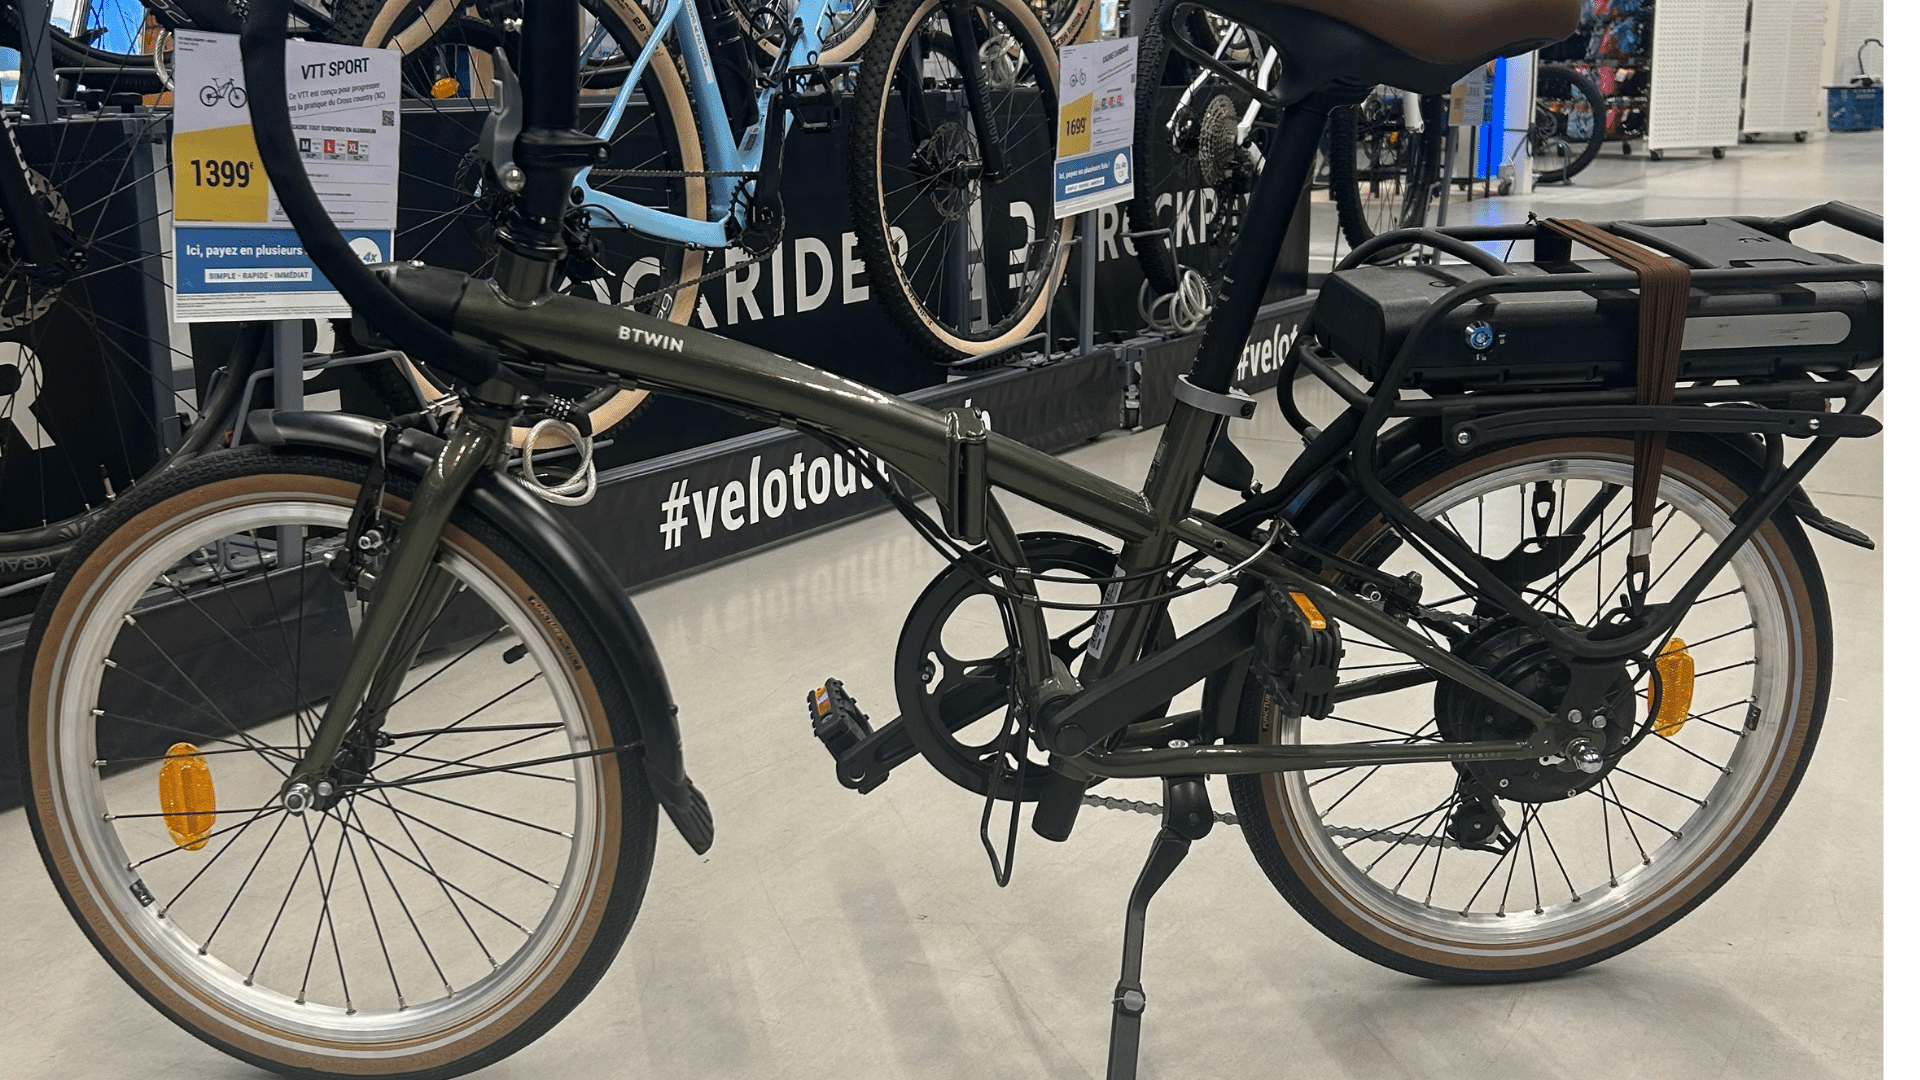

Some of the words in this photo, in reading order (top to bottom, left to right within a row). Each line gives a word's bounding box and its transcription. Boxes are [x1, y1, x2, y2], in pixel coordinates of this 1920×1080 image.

[632, 17, 646, 32] 29
[301, 62, 327, 80] VTT
[328, 57, 370, 78] SPORT
[288, 92, 296, 100] Ce
[298, 90, 310, 100] VTT
[310, 88, 320, 98] est
[320, 87, 337, 98] conçu
[337, 86, 352, 96] pour
[351, 82, 380, 94] progresser
[304, 100, 328, 112] pratique
[328, 97, 336, 107] du
[336, 96, 352, 105] Cross
[352, 93, 374, 104] country
[374, 90, 386, 102] (XC)
[301, 140, 310, 150] M
[348, 142, 358, 152] XL
[186, 244, 204, 258] Ici,
[206, 246, 238, 260] payez
[240, 246, 254, 256] en
[256, 244, 304, 258] plusieurs
[208, 272, 236, 280] SIMPLE
[242, 272, 268, 280] RAPIDE
[274, 270, 309, 279] IMMÉDIAT
[618, 325, 685, 351] BTWIN
[1262, 693, 1273, 730] PUNCTUR
